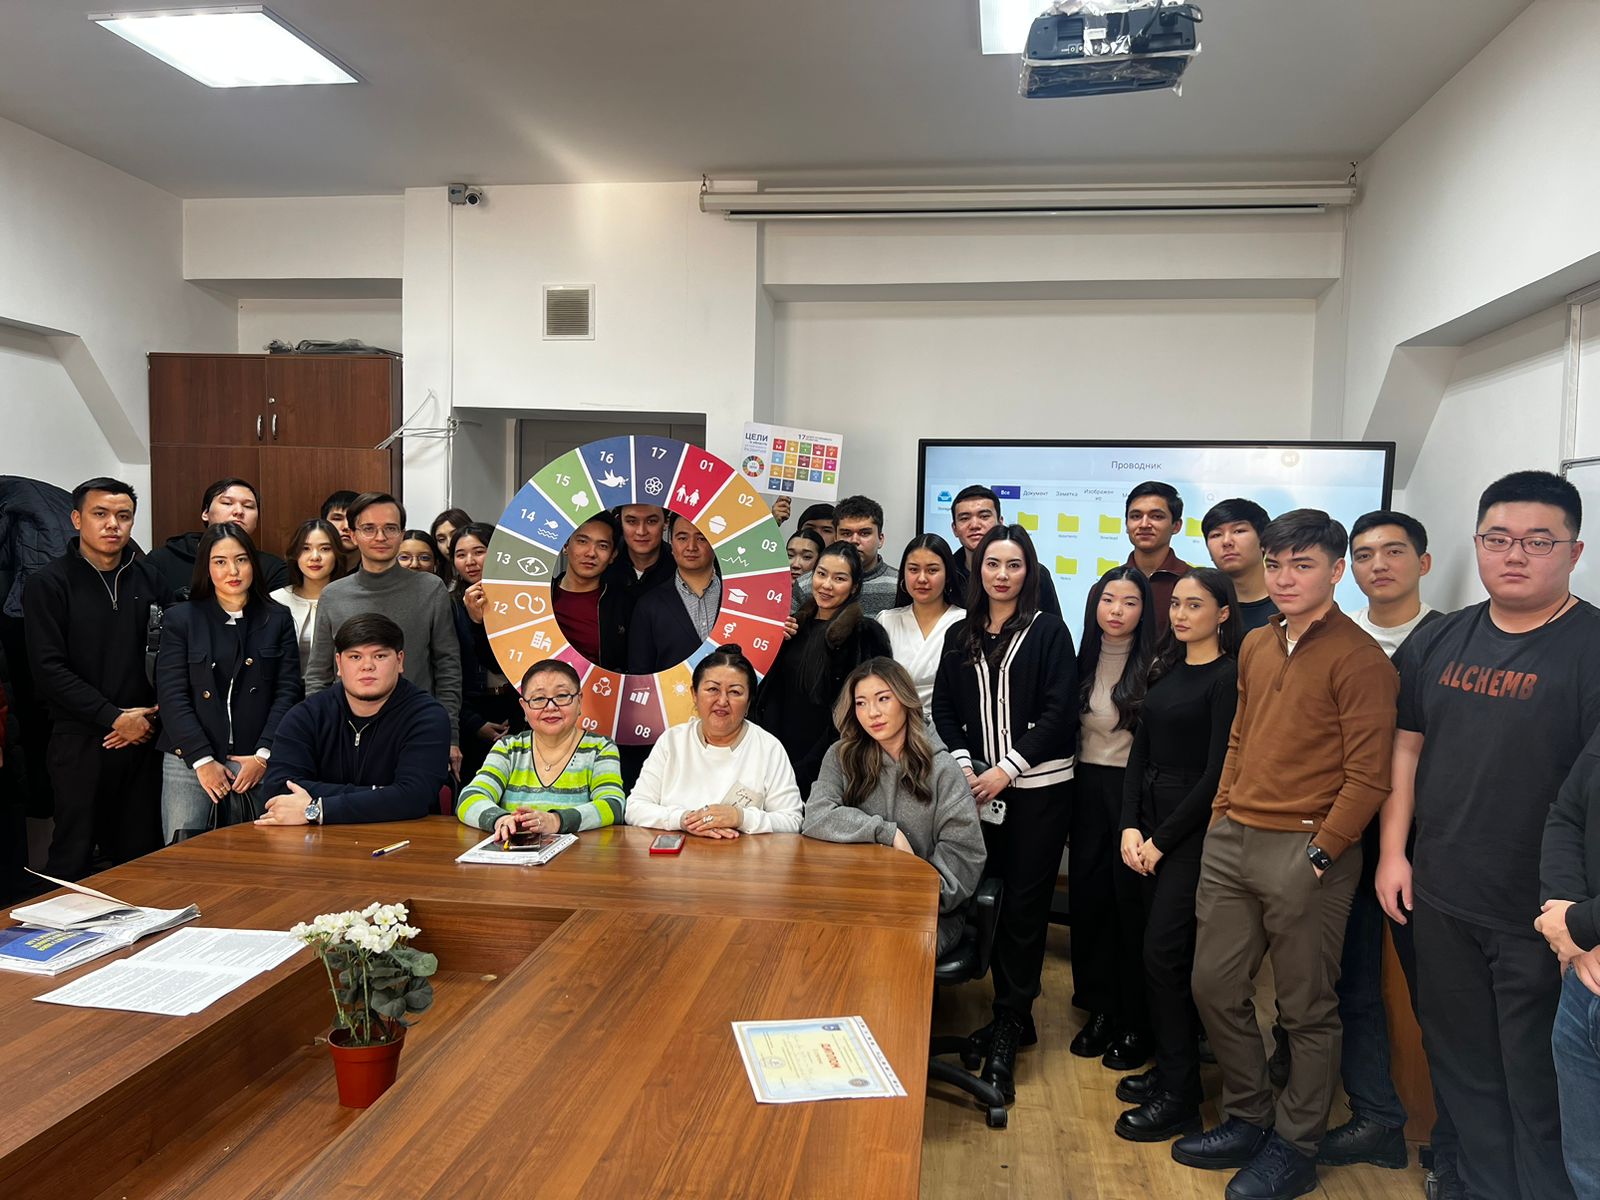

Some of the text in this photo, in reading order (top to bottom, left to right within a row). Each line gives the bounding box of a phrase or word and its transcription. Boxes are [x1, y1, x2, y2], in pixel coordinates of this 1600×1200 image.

[745, 432, 769, 442] ЦЕЛИ
[600, 451, 614, 464] 16
[651, 447, 667, 460] 17
[699, 459, 714, 472] 01
[1110, 460, 1162, 471] Проводник
[555, 473, 571, 487] 15
[738, 493, 754, 507] 02
[520, 508, 536, 522] 14
[761, 539, 778, 553] 03
[495, 551, 511, 565] 13
[766, 589, 783, 603] 04
[493, 601, 509, 614] 12
[752, 637, 769, 651] 05
[508, 649, 523, 662] 11
[1438, 661, 1538, 701] ALCHEMB
[582, 717, 598, 731] 09
[634, 724, 651, 739] 08
